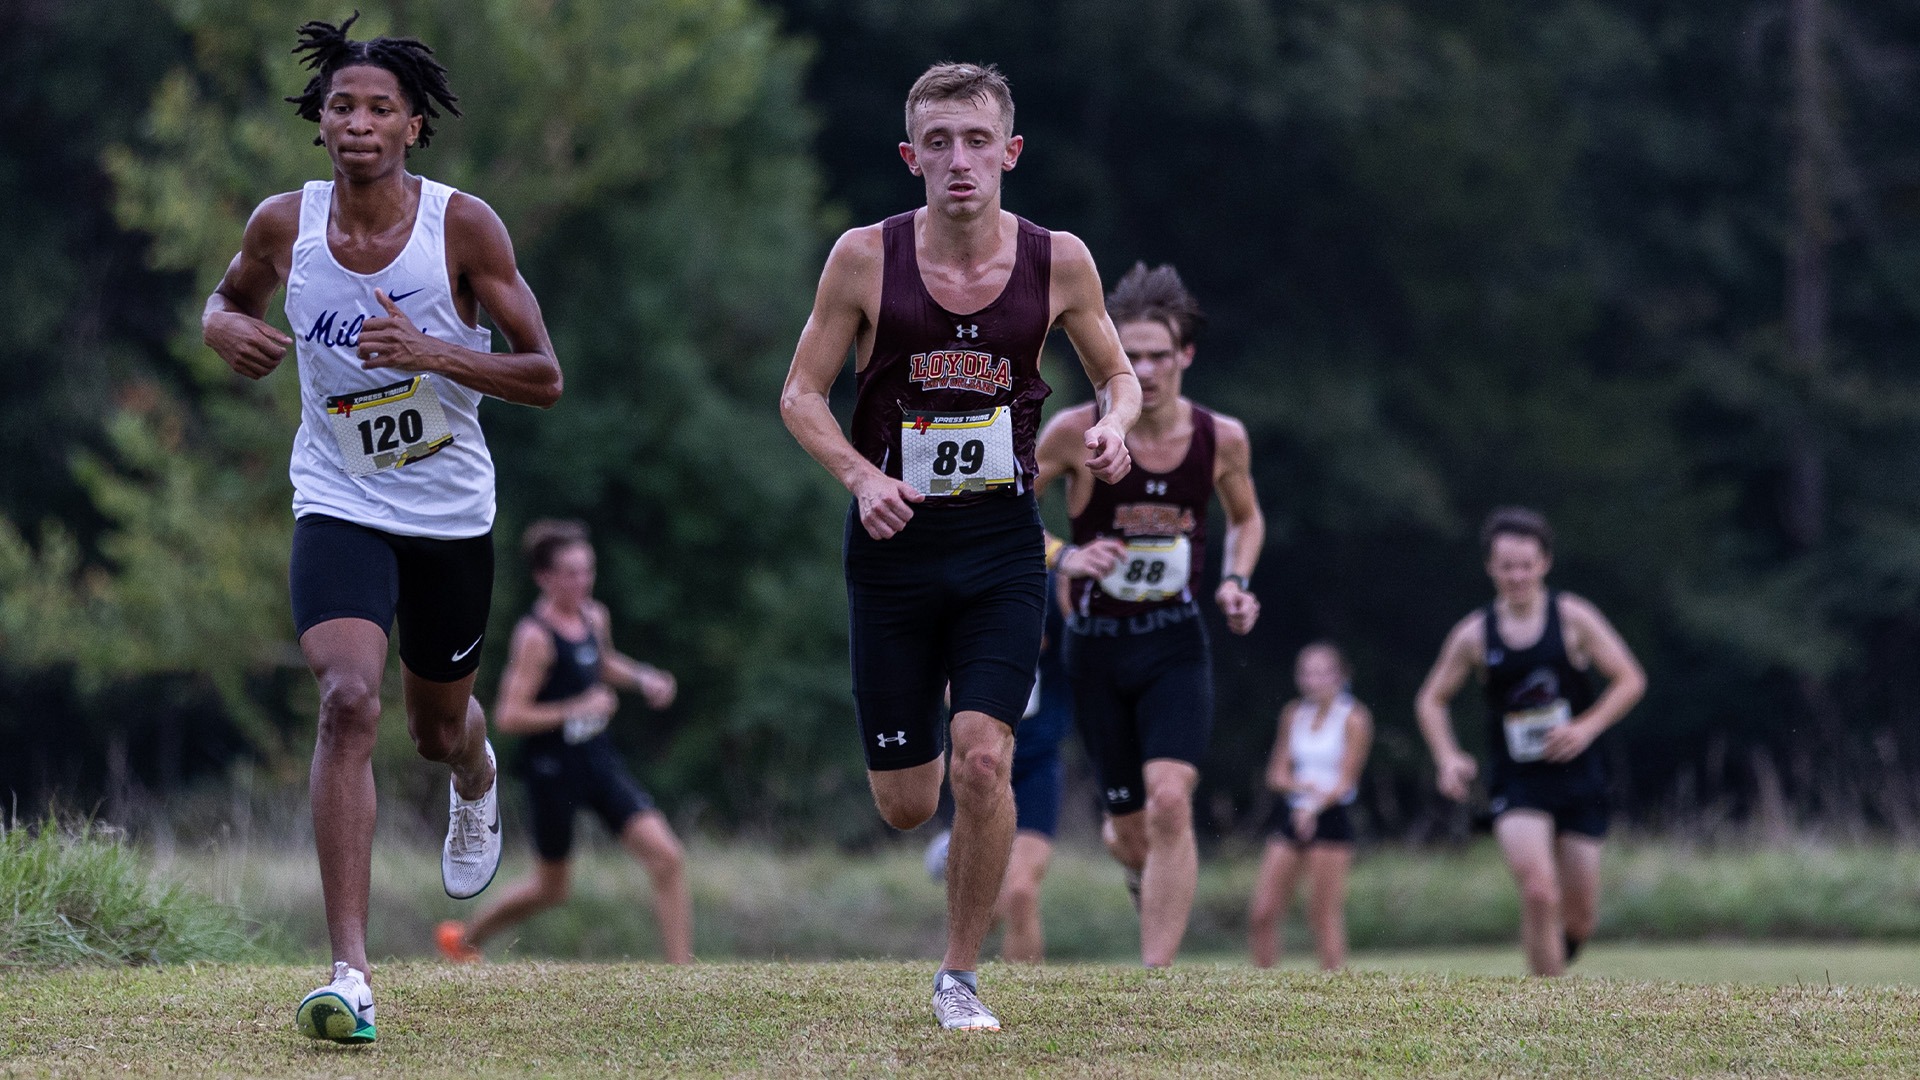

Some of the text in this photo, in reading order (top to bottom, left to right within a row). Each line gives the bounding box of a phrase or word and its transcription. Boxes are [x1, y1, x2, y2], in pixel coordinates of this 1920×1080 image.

[305, 310, 376, 348] Mil
[911, 351, 1012, 391] LOYOLA
[923, 378, 949, 391] NEW
[353, 385, 409, 404] XPRESS TIMING
[357, 409, 423, 455] 120
[965, 413, 990, 422] TIMING
[933, 439, 985, 476] 89
[1125, 559, 1166, 584] 88
